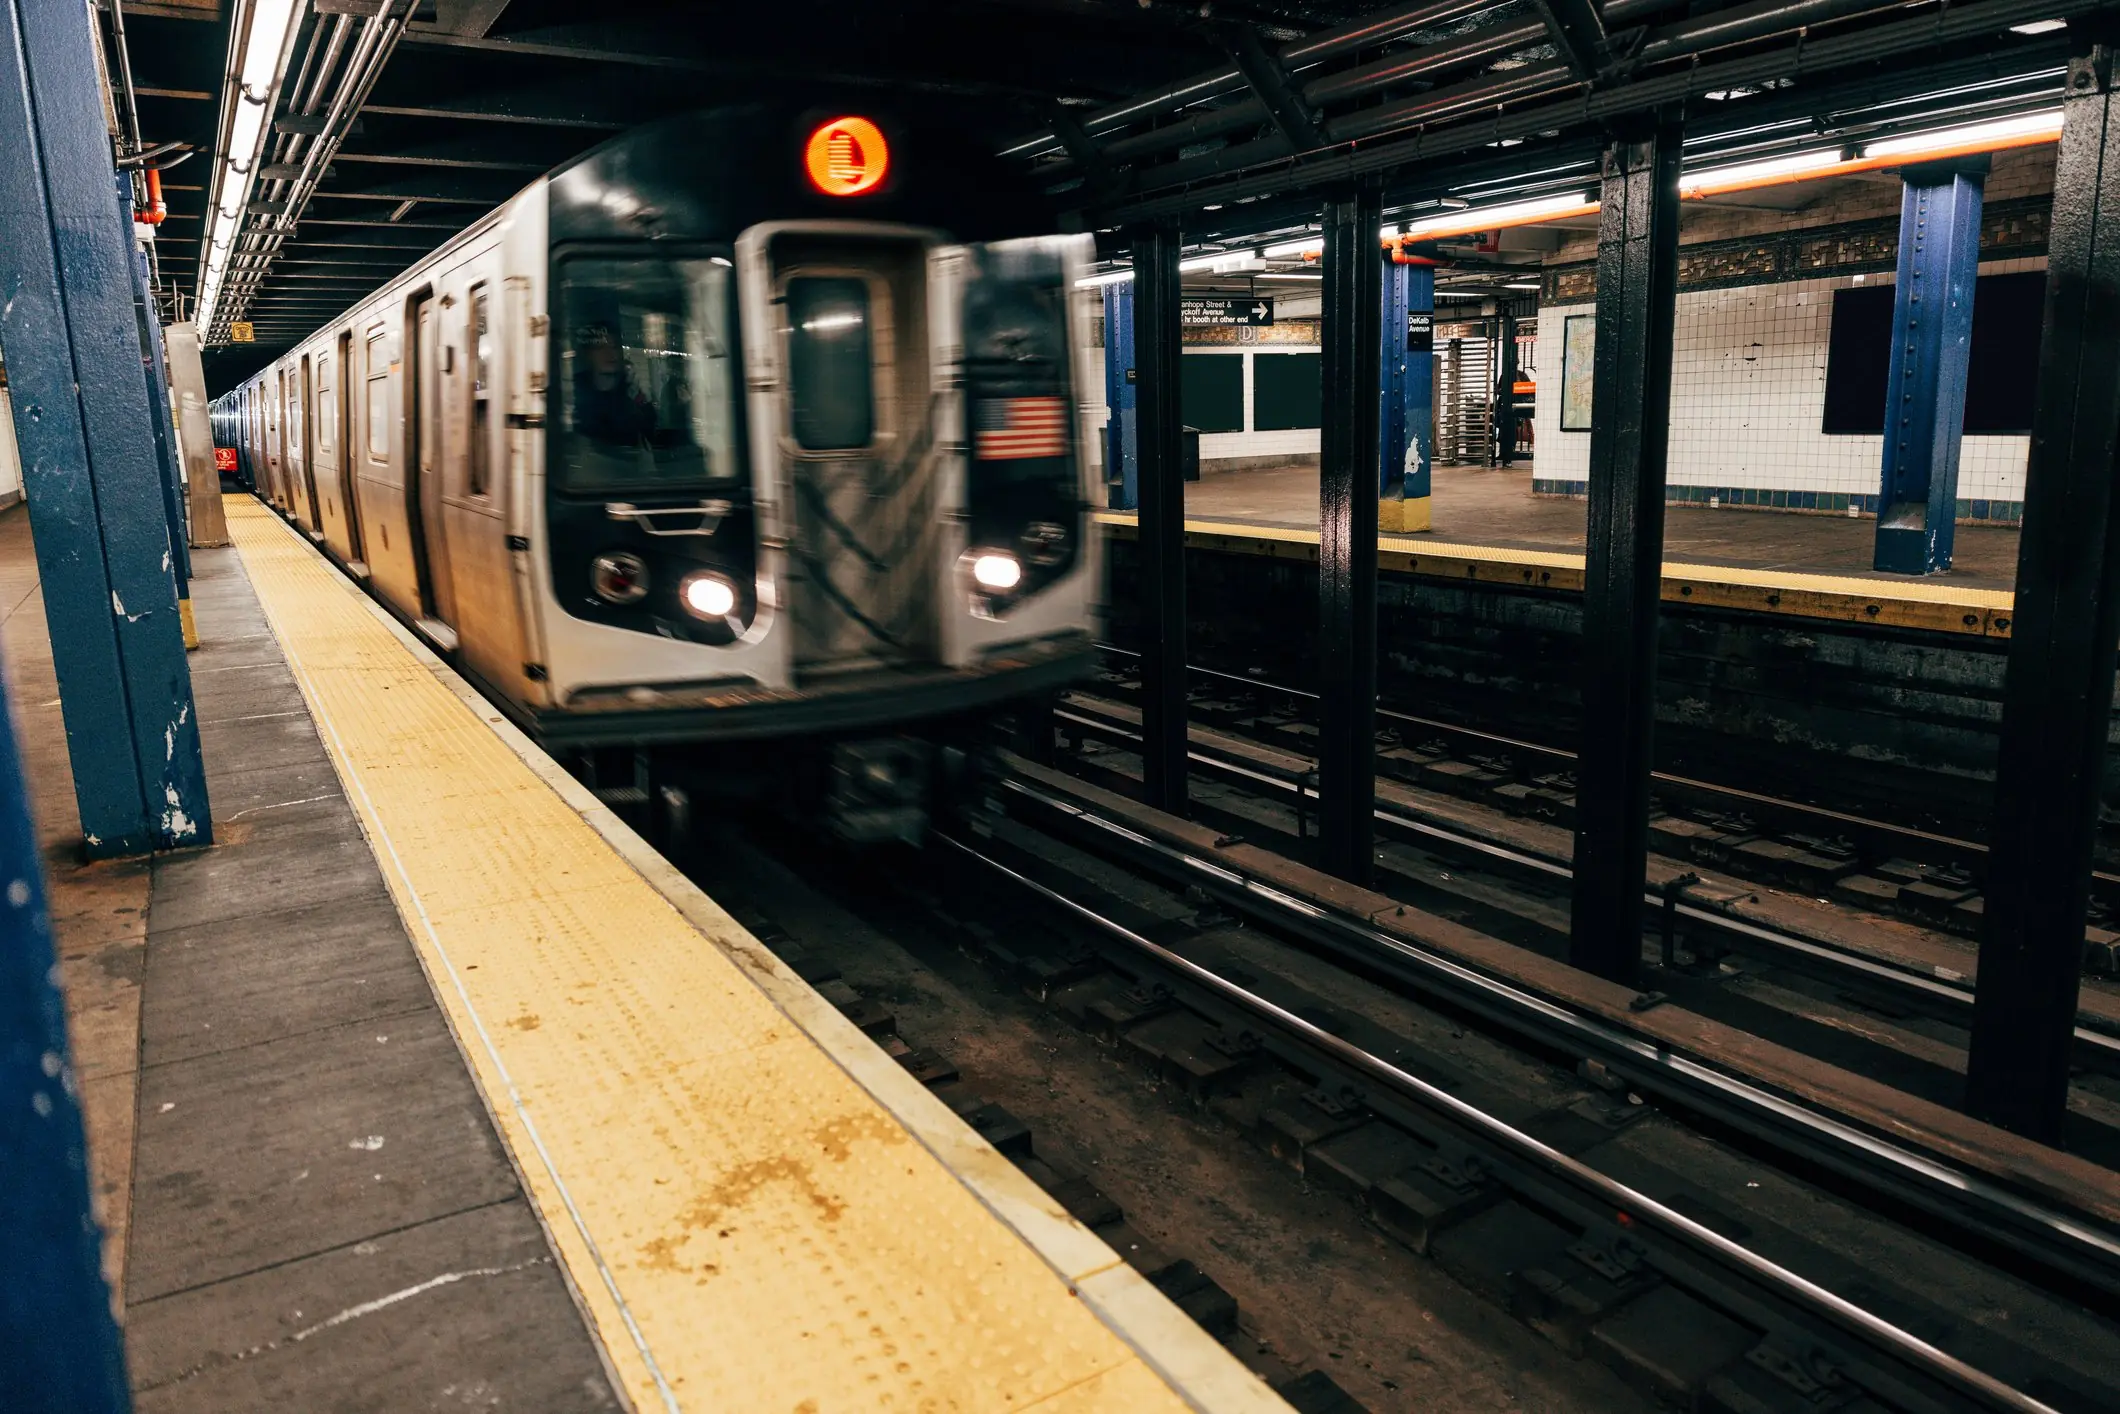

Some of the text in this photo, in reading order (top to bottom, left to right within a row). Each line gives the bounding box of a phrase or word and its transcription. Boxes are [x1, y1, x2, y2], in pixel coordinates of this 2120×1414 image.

[828, 135, 866, 179] L
[1181, 308, 1201, 316] yckoff
[1515, 335, 1538, 343] EMERGE
